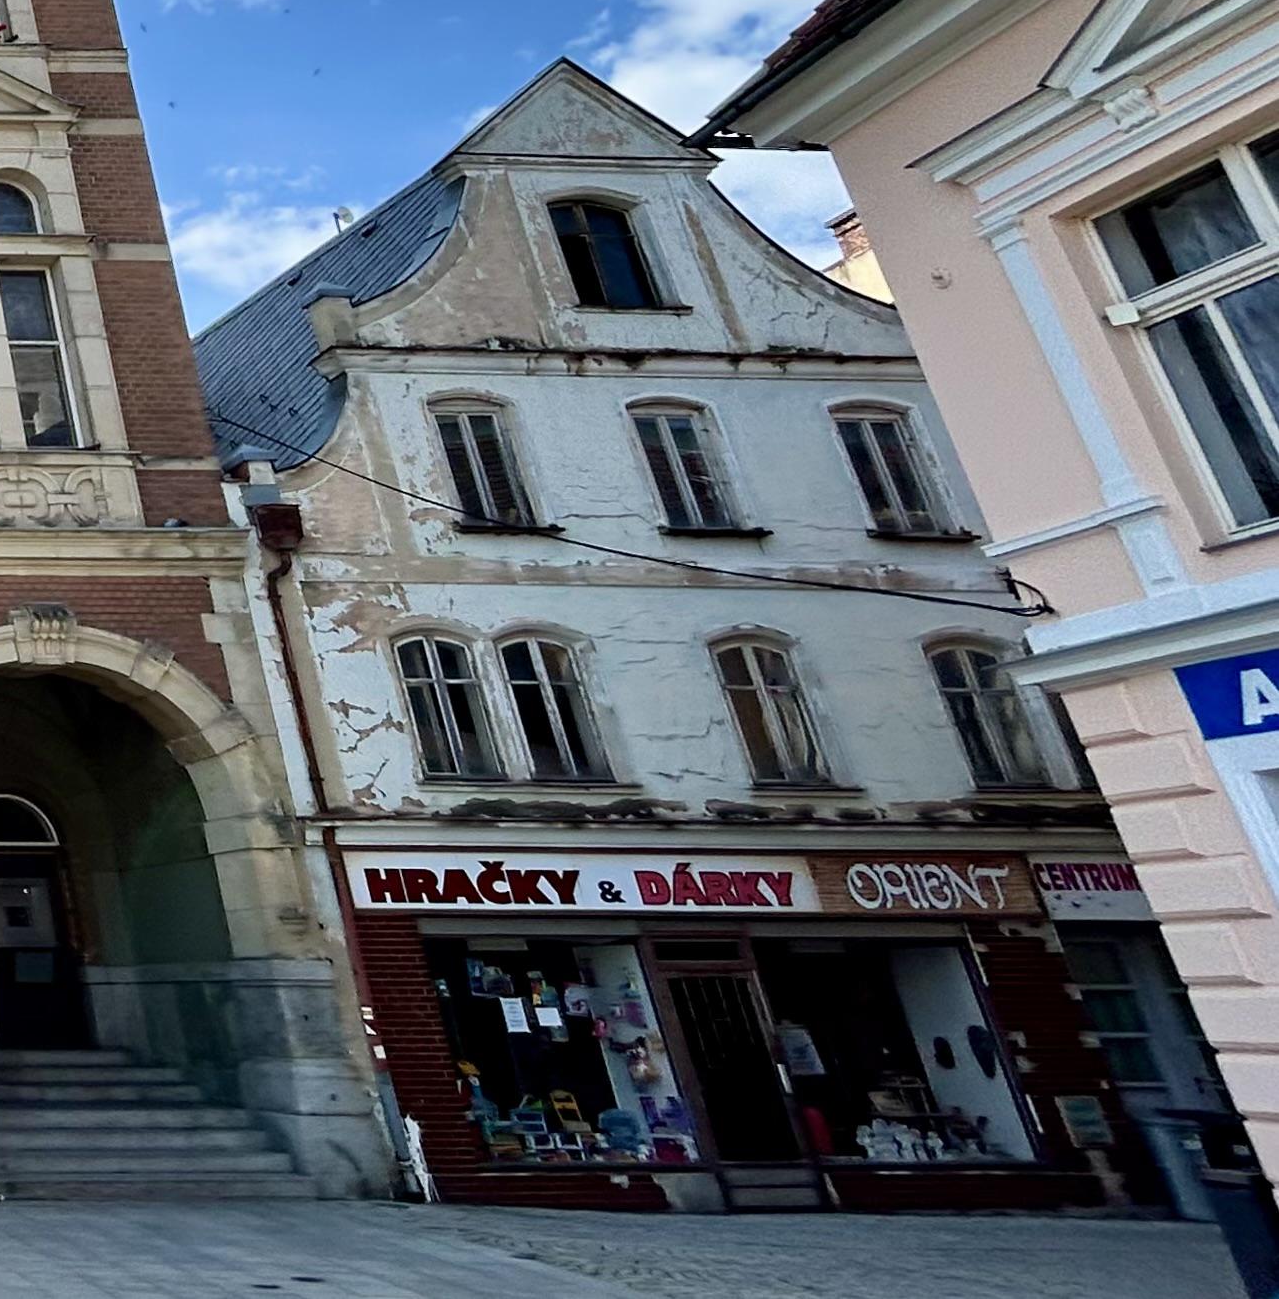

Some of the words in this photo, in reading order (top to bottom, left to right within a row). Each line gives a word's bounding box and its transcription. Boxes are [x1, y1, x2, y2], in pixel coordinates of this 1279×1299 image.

[363, 861, 580, 906] HRAČKY
[598, 880, 625, 904] &
[633, 862, 794, 908] DÁRKY
[846, 862, 1009, 910] ORIENT
[1033, 863, 1143, 892] CENTRUM
